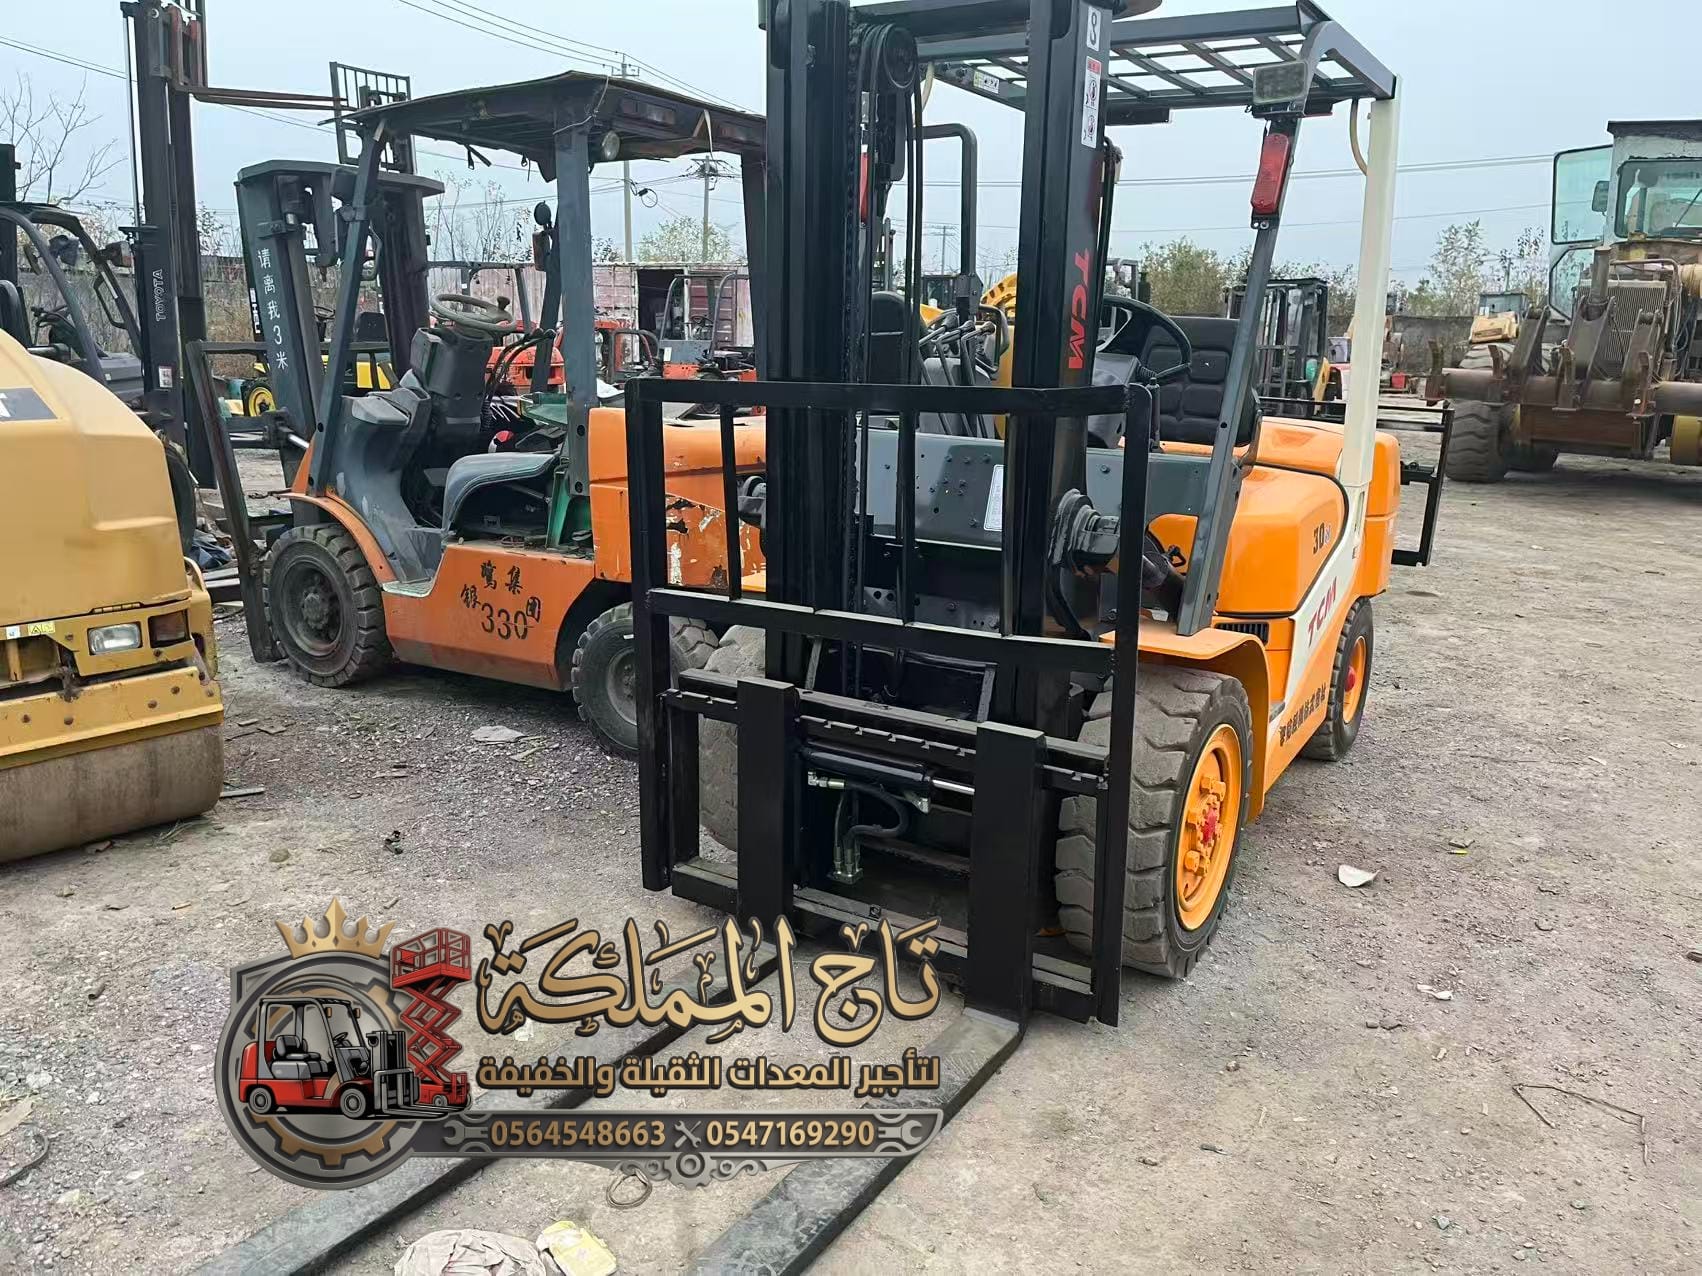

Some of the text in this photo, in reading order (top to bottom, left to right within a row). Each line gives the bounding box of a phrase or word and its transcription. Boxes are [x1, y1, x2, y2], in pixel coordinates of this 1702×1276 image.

[152, 268, 167, 322] TOYOTA
[257, 247, 289, 370] 请离我3米
[1068, 247, 1089, 369] TCM
[481, 602, 529, 640] 330
[1308, 576, 1337, 648] TCM
